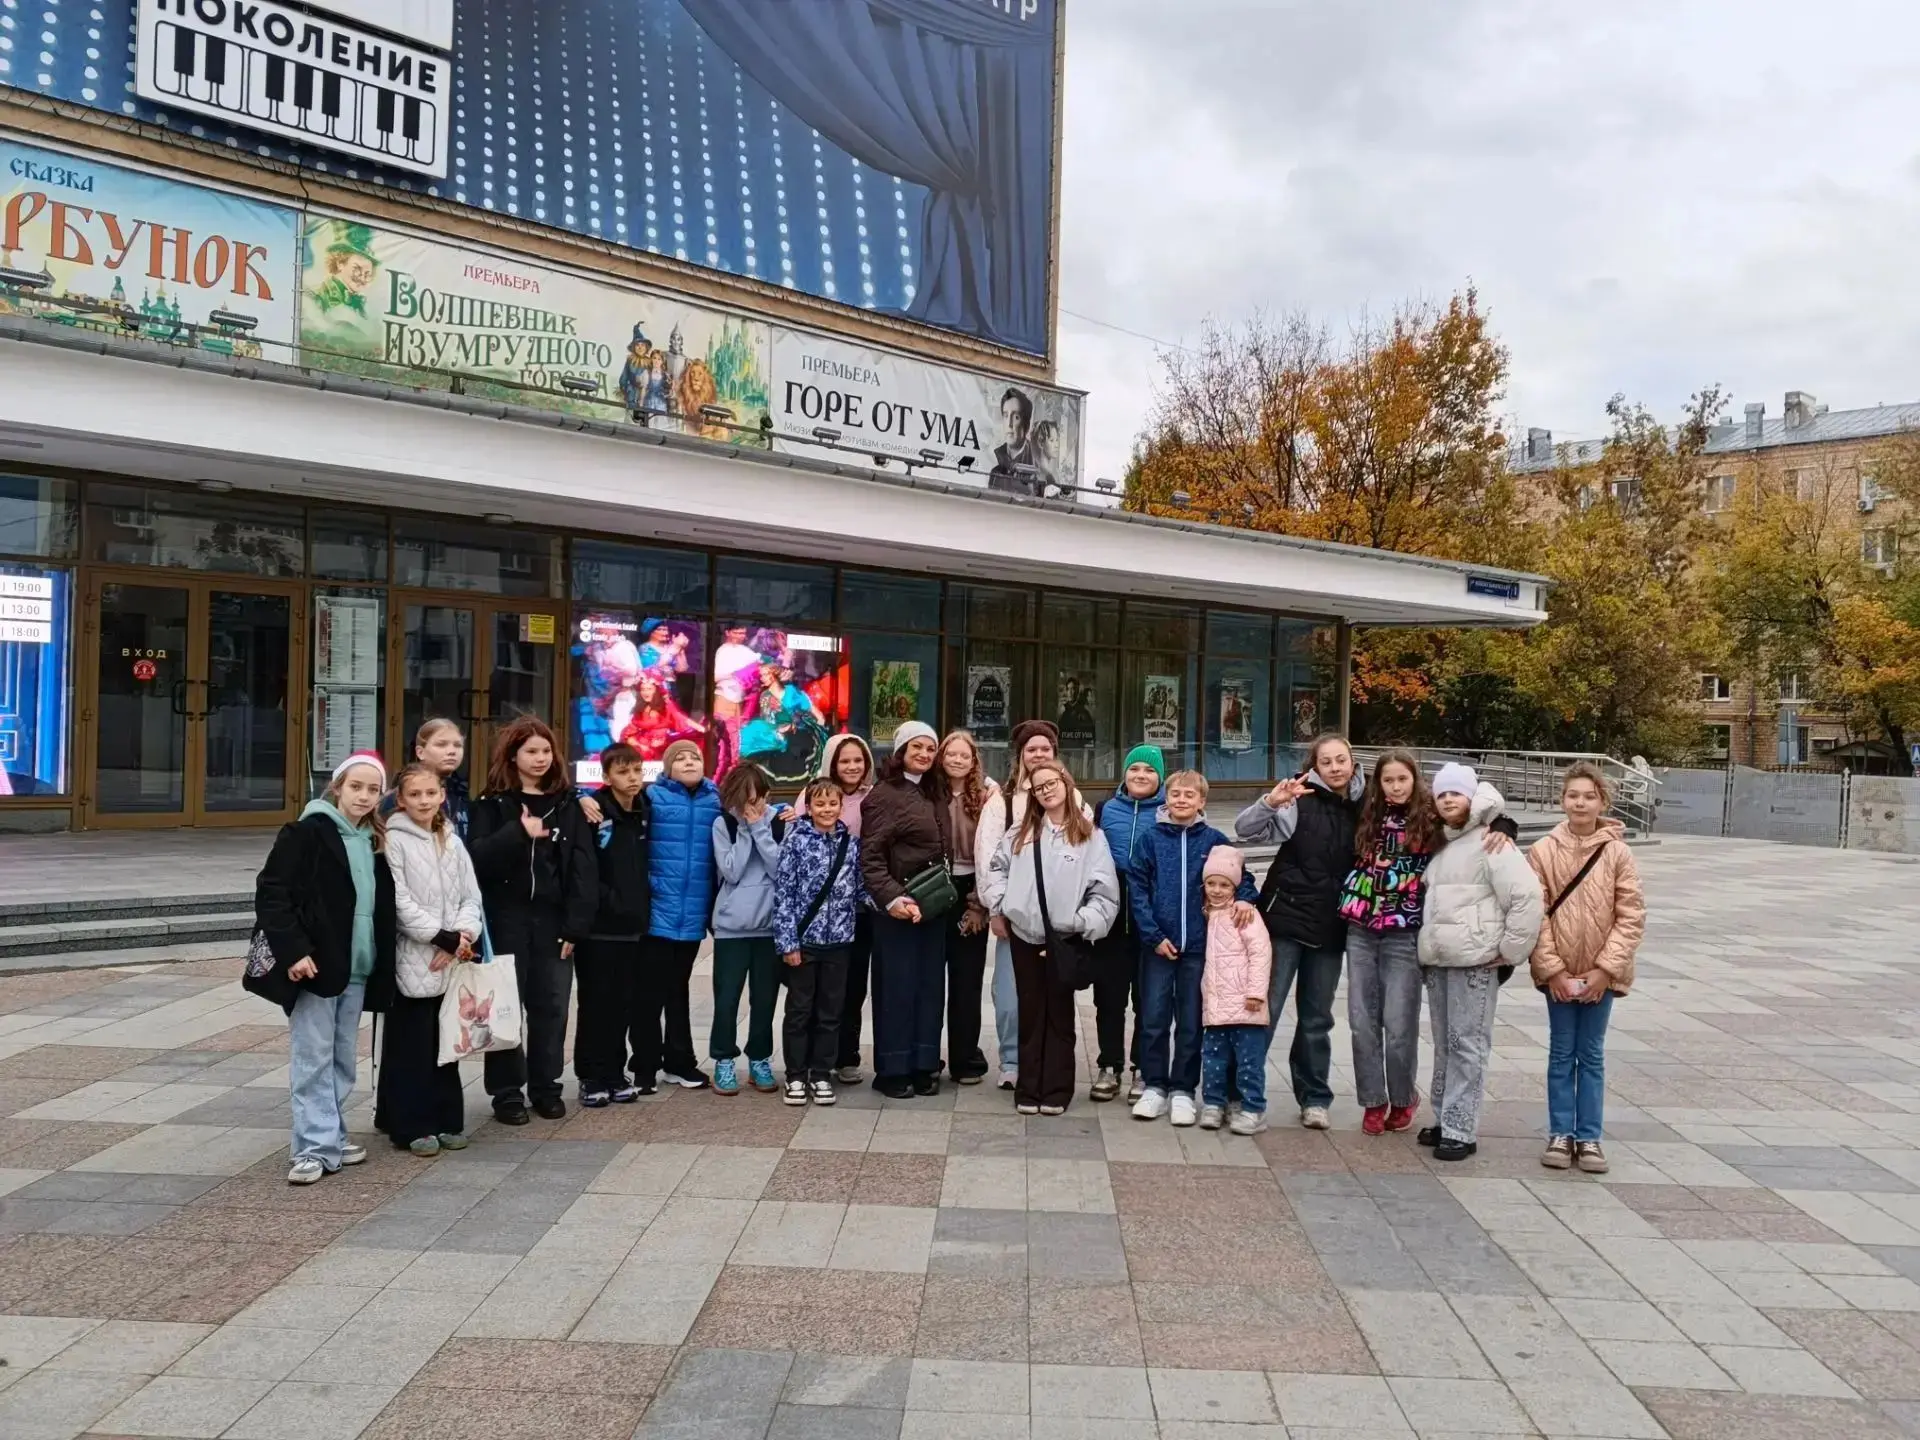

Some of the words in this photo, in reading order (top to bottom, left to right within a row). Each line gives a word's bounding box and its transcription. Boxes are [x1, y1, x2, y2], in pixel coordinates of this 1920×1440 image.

[9, 157, 95, 193] СКАЗКА
[0, 191, 274, 301] РБУНОК
[463, 264, 541, 294] ПРЕМЬЕРА
[385, 268, 578, 337] ВОЛШЕБНИК
[384, 319, 613, 370] ИЗУМРУДНОГО
[801, 354, 881, 387] ПРЕМЬЕРА
[784, 380, 863, 429] ГОРЕ
[871, 400, 913, 437] ОТ
[920, 408, 982, 450] УМА
[12, 582, 42, 593] 19:00
[11, 604, 41, 615] 13:00
[11, 626, 40, 638] 18:00
[121, 647, 167, 659] ВХОД
